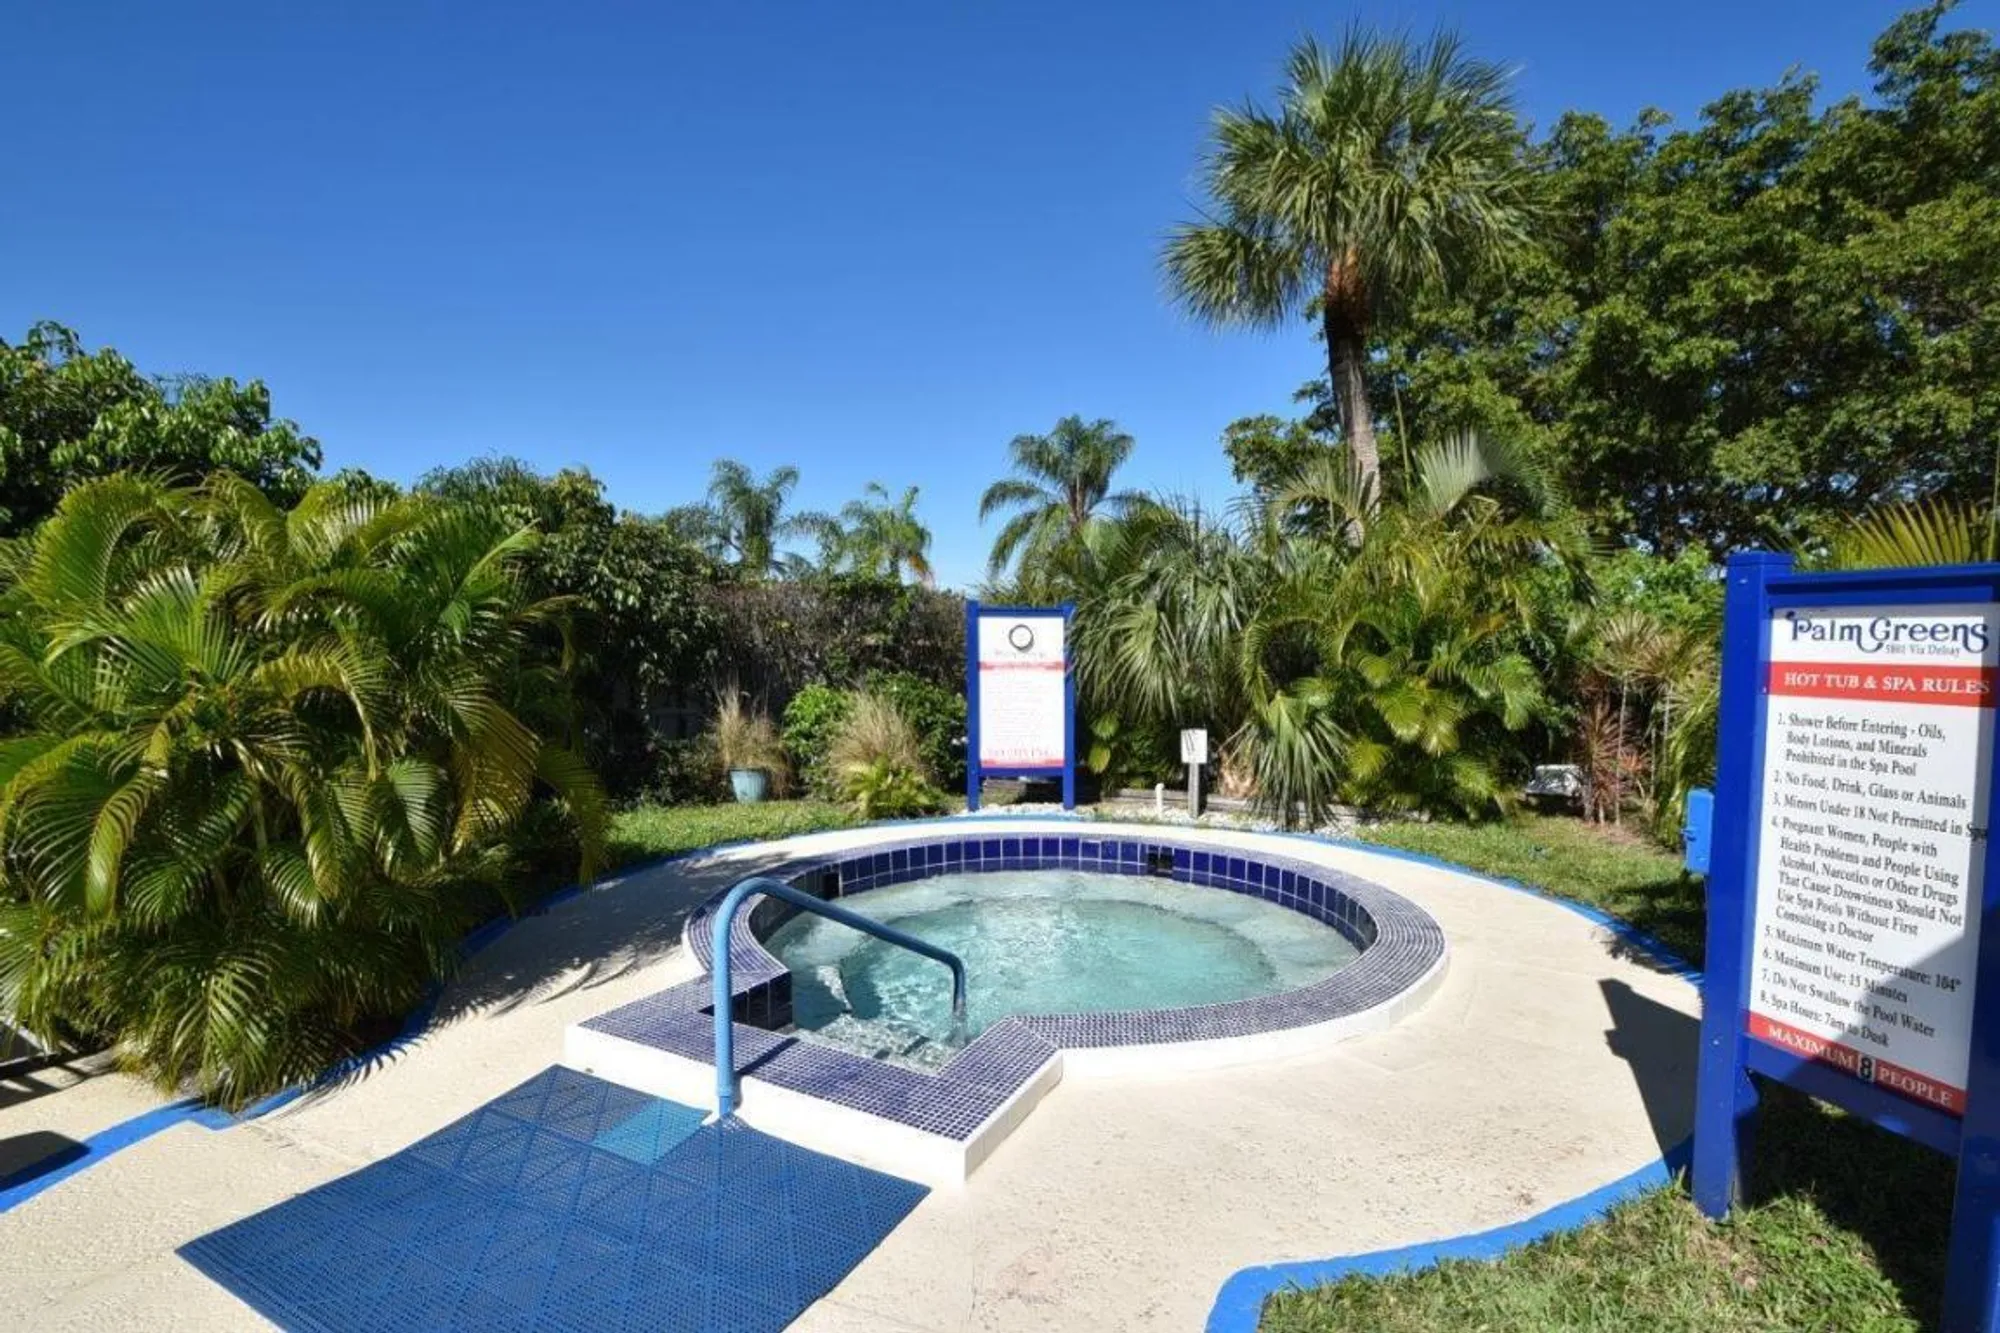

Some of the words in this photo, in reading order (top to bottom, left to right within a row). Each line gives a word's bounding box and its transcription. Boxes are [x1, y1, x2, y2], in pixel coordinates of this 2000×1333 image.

[1786, 611, 1883, 653] Palm
[1869, 616, 1990, 653] Greens
[1784, 672, 1820, 686] HOT
[1823, 674, 1859, 688] TUB
[1863, 675, 1877, 690] &
[1882, 676, 1916, 691] SPA
[1920, 678, 1990, 694] RULES
[1788, 712, 1824, 729] Shower
[1826, 715, 1859, 731] Before
[1861, 719, 1908, 739] Entering
[1919, 723, 1946, 740] Oils,
[1786, 748, 1835, 767] Prohibited
[1837, 754, 1848, 768] in
[1850, 756, 1867, 770] the
[1869, 758, 1889, 776] Spa
[1892, 760, 1917, 776] Pool
[1856, 738, 1875, 752] and
[1879, 740, 1928, 758] Minerals
[1786, 771, 1800, 786] No
[1801, 773, 1829, 791] Food,
[1832, 777, 1866, 797] Drink,
[1868, 783, 1899, 800] Glass
[1901, 790, 1914, 802] or
[1916, 789, 1967, 810] Animals
[1784, 794, 1818, 812] Minors
[1820, 799, 1851, 816] Under
[1853, 805, 1866, 819] 18
[1868, 807, 1889, 823] Not
[1892, 810, 1947, 833] Permitted
[1951, 819, 1963, 836] in
[1828, 824, 1869, 847] Women,
[1872, 833, 1909, 853] People
[1911, 841, 1938, 857] with
[1814, 843, 1859, 865] Problems
[1861, 855, 1882, 870] and
[1884, 857, 1921, 878] People
[1924, 864, 1960, 889] Using
[1871, 877, 1885, 889] or
[1886, 877, 1920, 898] Other
[1922, 884, 1958, 908] Drugs
[1846, 904, 1890, 929] Without
[1892, 916, 1919, 936] First
[1896, 898, 1936, 920] Should
[1939, 908, 1962, 926] Not
[1838, 920, 1875, 942] Doctor
[1776, 928, 1823, 953] Maximum
[1826, 942, 1857, 962] Water
[1859, 951, 1931, 986] Temperature:
[1774, 949, 1822, 975] Maximum
[1863, 977, 1908, 1003] Minutes
[1772, 971, 1788, 987] Do
[1790, 976, 1808, 994] Not
[1809, 983, 1852, 1008] Swallow
[1854, 999, 1871, 1016] the
[1873, 1004, 1898, 1026] Pool
[1901, 1012, 1937, 1039] Water
[1825, 1011, 1846, 1033] 7am
[1847, 1022, 1860, 1036] to
[1861, 1024, 1890, 1048] Dusk
[1768, 1024, 1855, 1069] MAXIMUM
[1859, 1056, 1875, 1081] 8
[1879, 1066, 1954, 1107] PEOPLE
